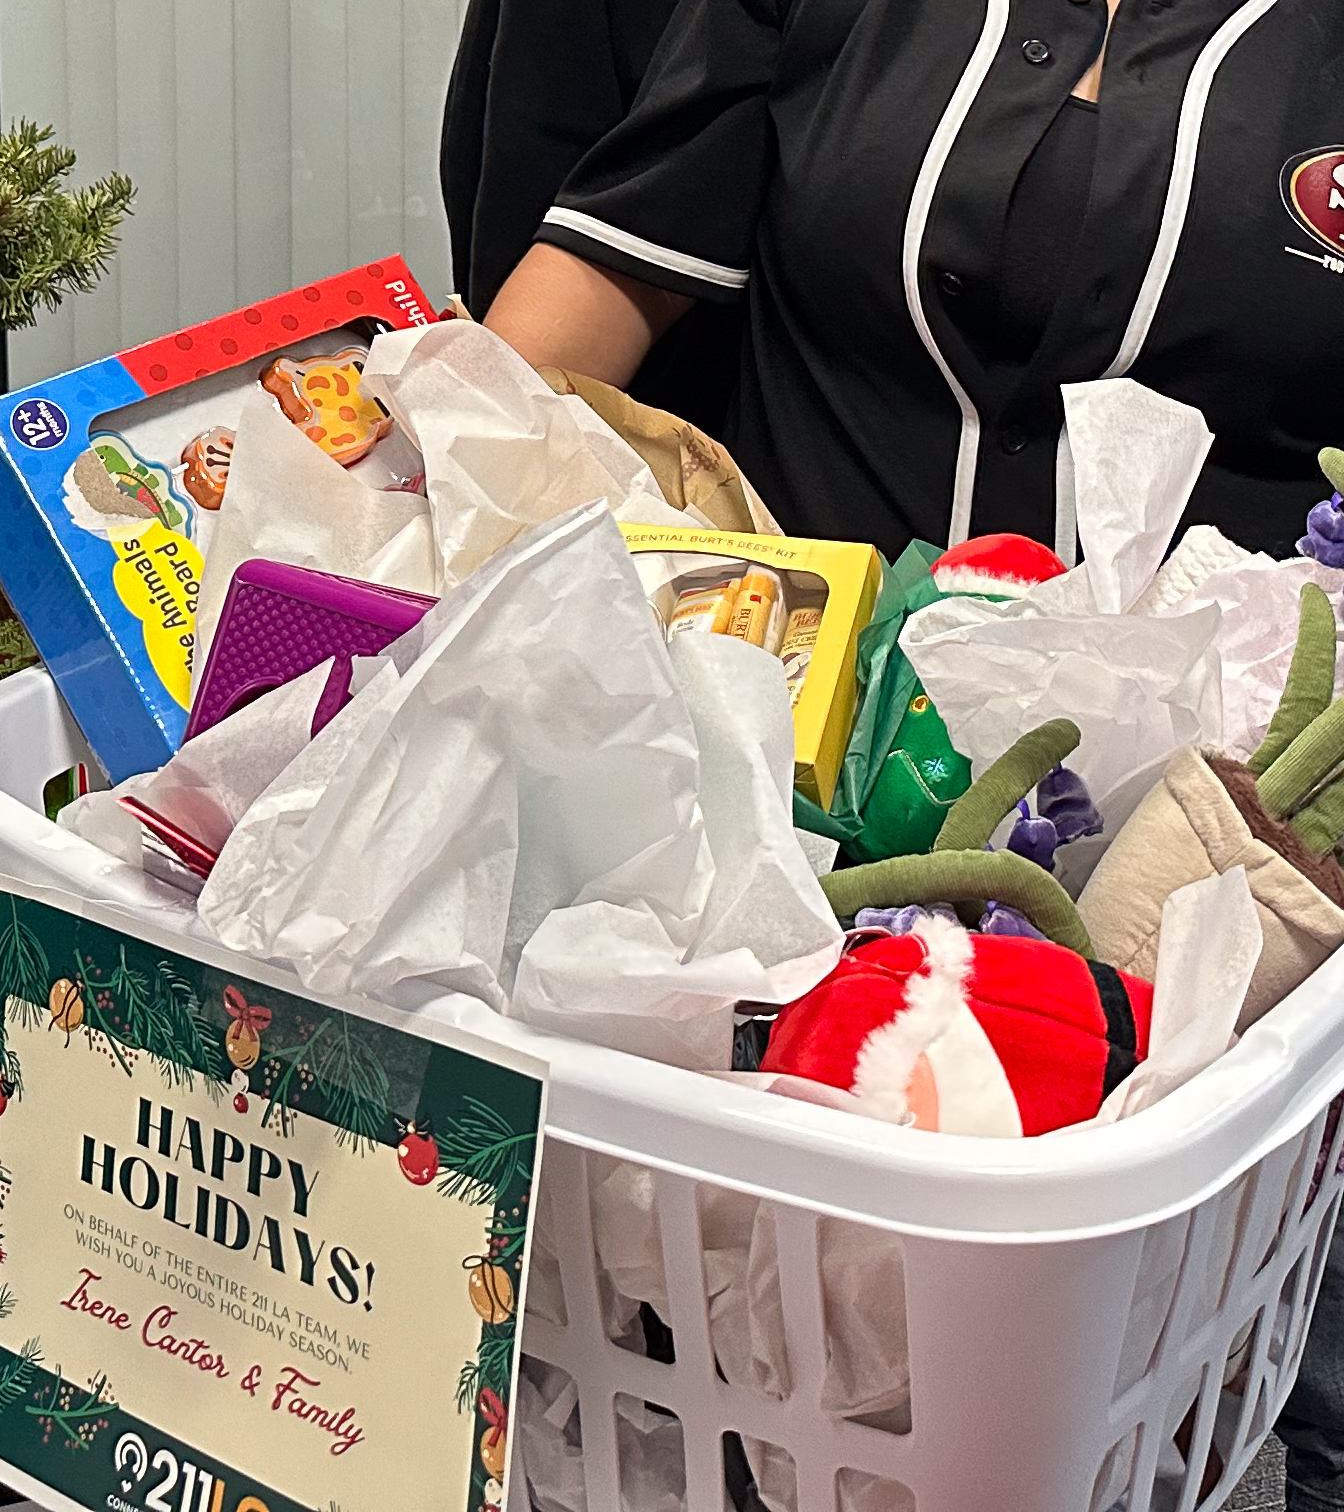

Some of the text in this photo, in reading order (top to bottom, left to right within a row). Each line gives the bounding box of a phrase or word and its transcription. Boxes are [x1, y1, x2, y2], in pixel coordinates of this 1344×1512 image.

[17, 408, 50, 446] 12+
[36, 401, 64, 438] months
[123, 538, 188, 630] Animals
[775, 547, 798, 560] KIT
[136, 1096, 320, 1218] HAPPY
[63, 1203, 371, 1360] ON BEHALF OF THE ENTIRE 211 LA TEAM, WE
[80, 1133, 376, 1313] HOLIDAYS!
[59, 1267, 365, 1456] Irene Cantor & Family
[74, 1228, 353, 1375] WISH YOU A JOYOUS HOLIDAY SEASON.
